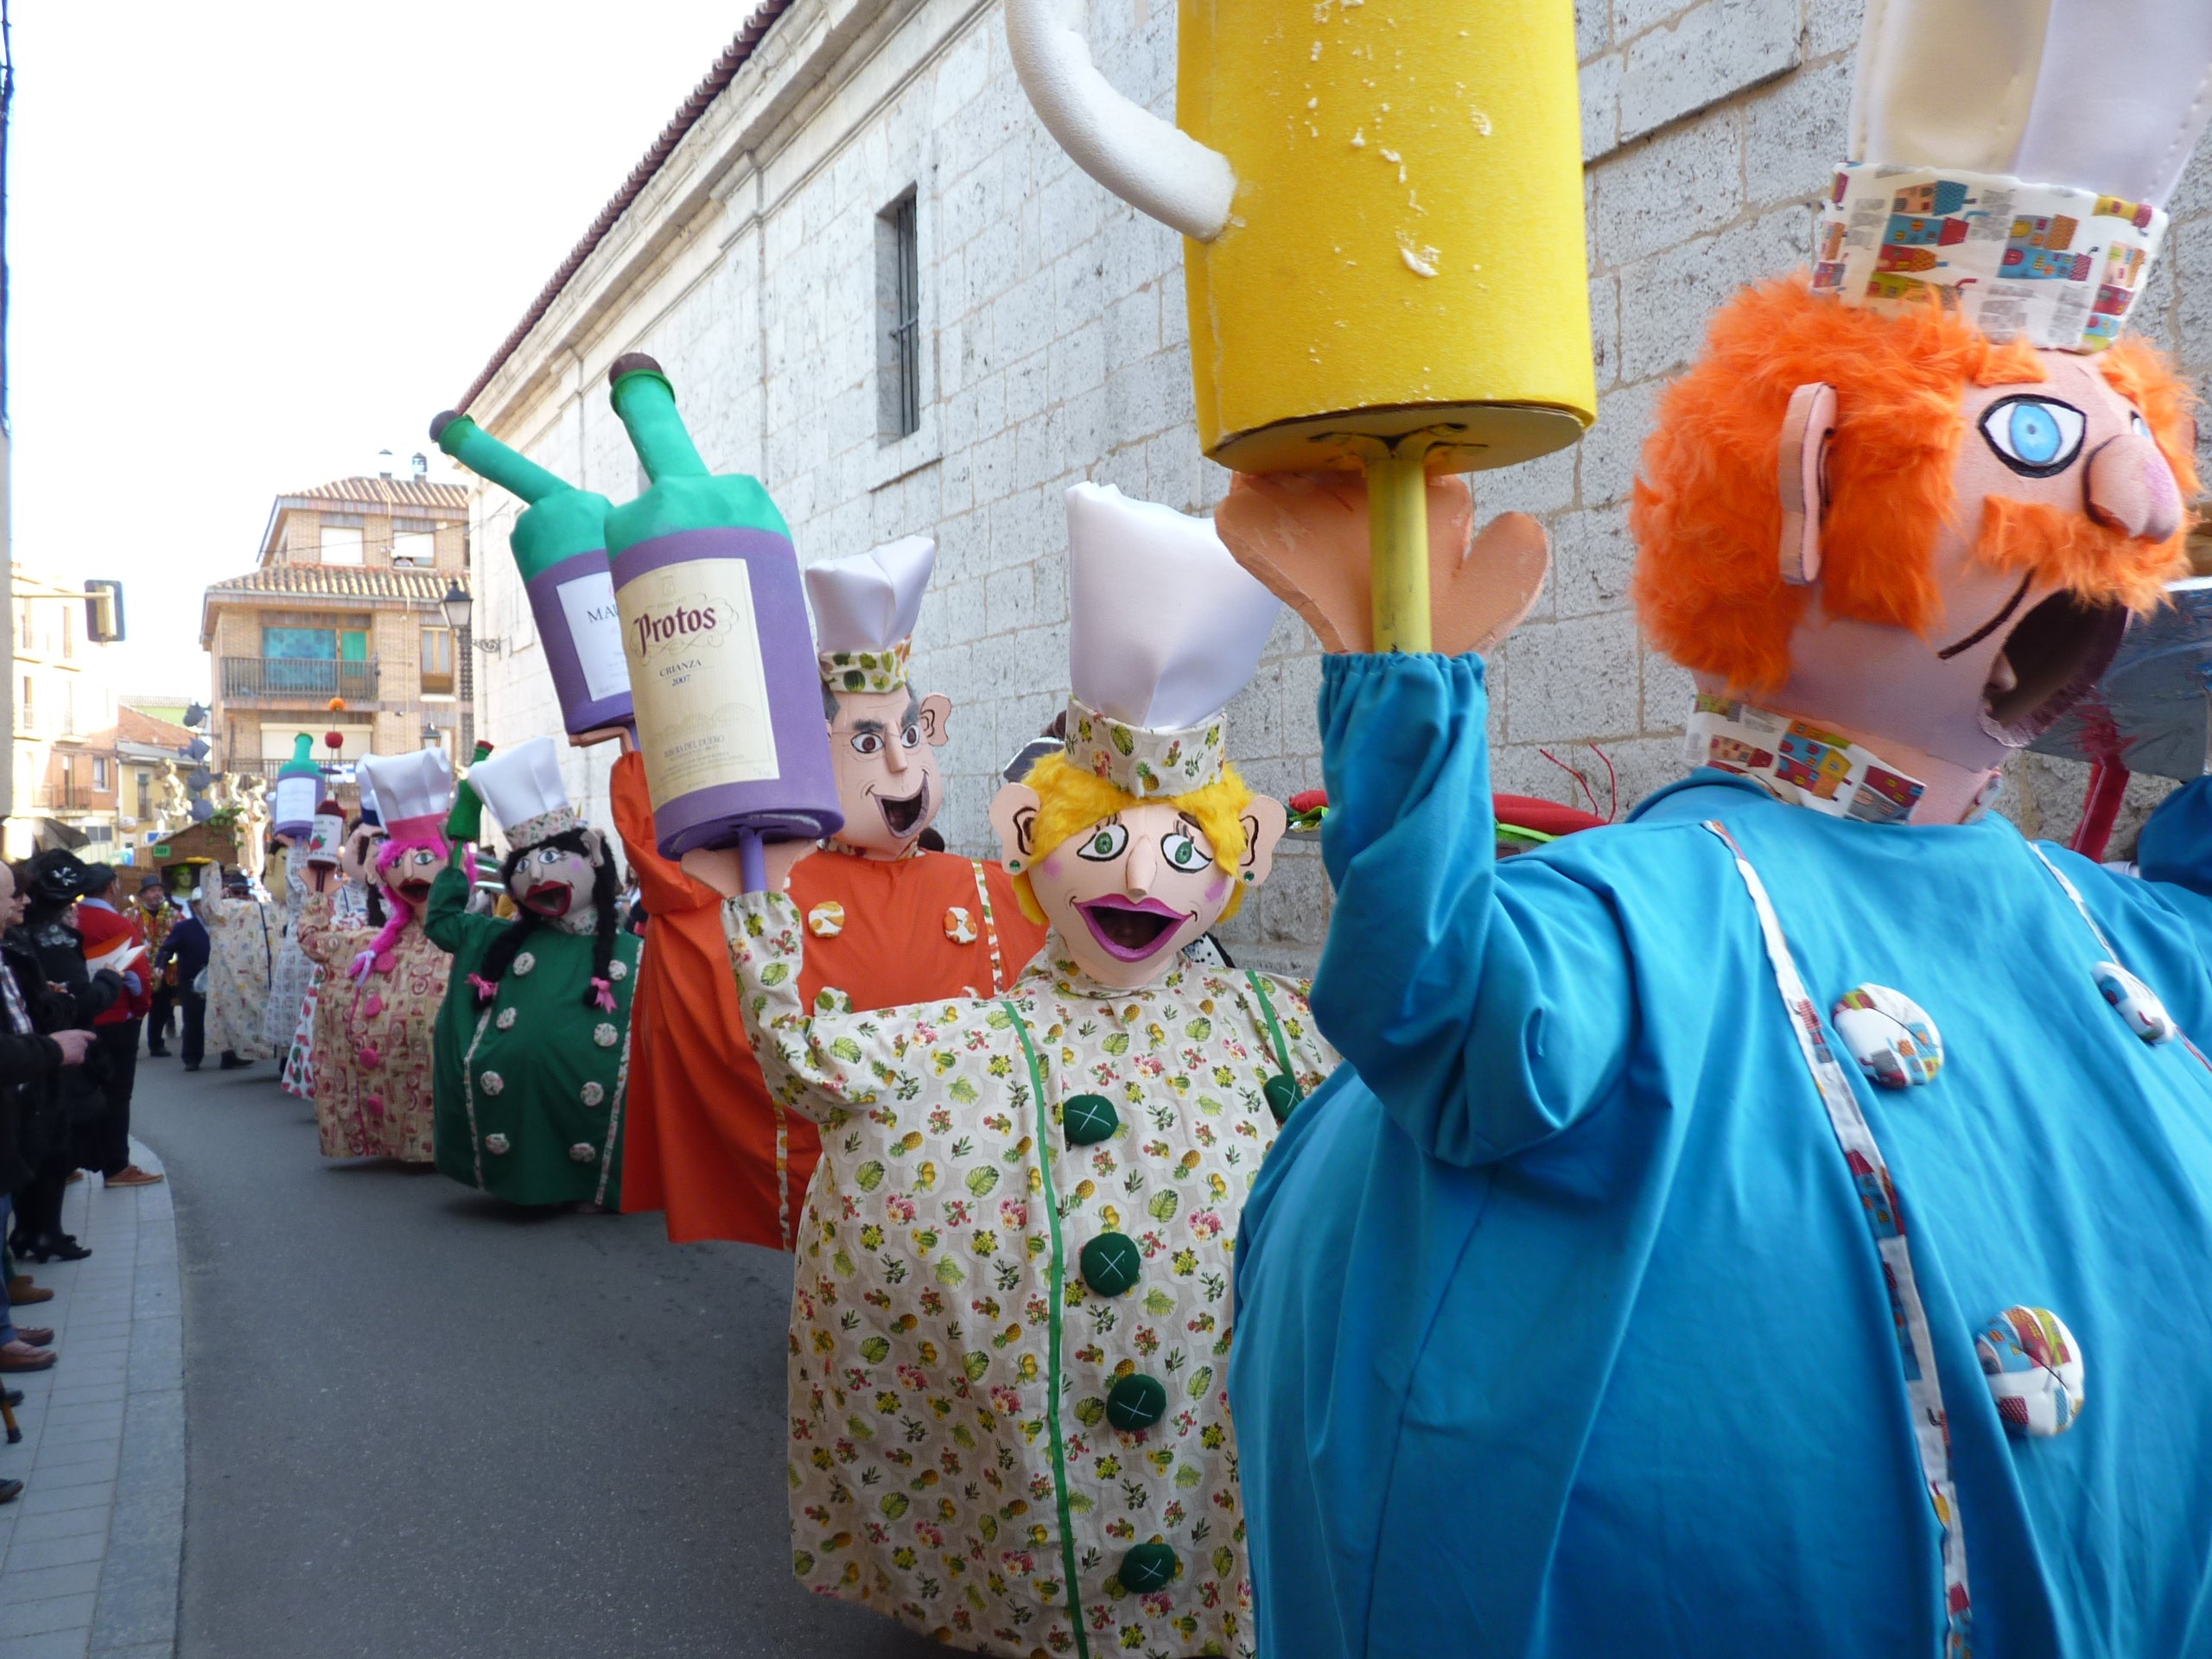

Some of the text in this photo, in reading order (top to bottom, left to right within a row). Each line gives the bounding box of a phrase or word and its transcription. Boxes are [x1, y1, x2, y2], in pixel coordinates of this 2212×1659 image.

[632, 604, 716, 658] Protos
[659, 658, 702, 677] CRIANZA
[671, 674, 691, 687] 2007
[698, 734, 725, 748] DUERO
